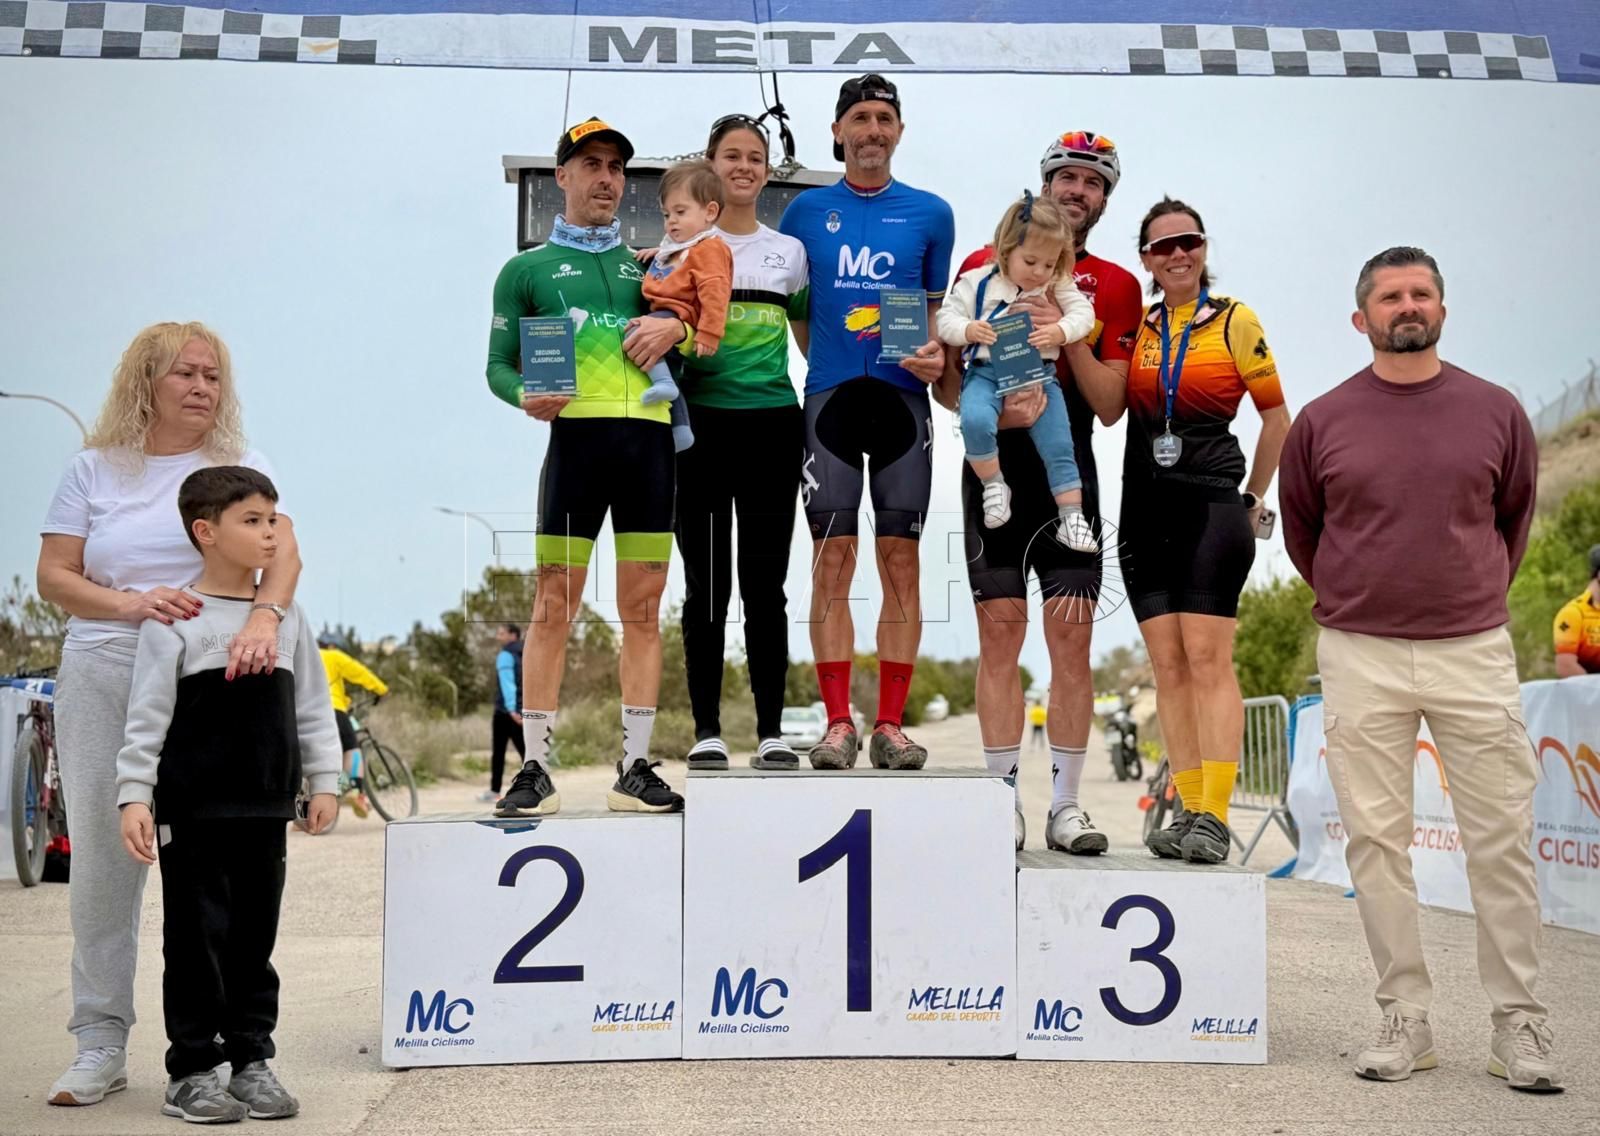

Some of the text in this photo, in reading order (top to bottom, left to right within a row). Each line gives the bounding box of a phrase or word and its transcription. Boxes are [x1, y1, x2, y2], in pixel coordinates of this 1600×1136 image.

[588, 25, 916, 65] META
[834, 279, 897, 290] Melilla Ciclismo
[1538, 837, 1600, 869] CICLIS
[493, 845, 585, 984] 2
[798, 809, 872, 1012] 1
[1099, 894, 1182, 1026] 3
[908, 986, 1004, 1011] MELILLA
[593, 1000, 675, 1023] MELILLA
[941, 1012, 957, 1021] DEL
[959, 1011, 1001, 1021] DEPORTE
[621, 1023, 634, 1031] DEL
[637, 1022, 672, 1031] DEPORTE
[698, 1021, 790, 1034] Melilla Ciclismo
[1192, 1017, 1258, 1035] MELILLA
[394, 1037, 475, 1048] Melilla Ciclismo
[1026, 1032, 1083, 1042] Melilla Ciclismo
